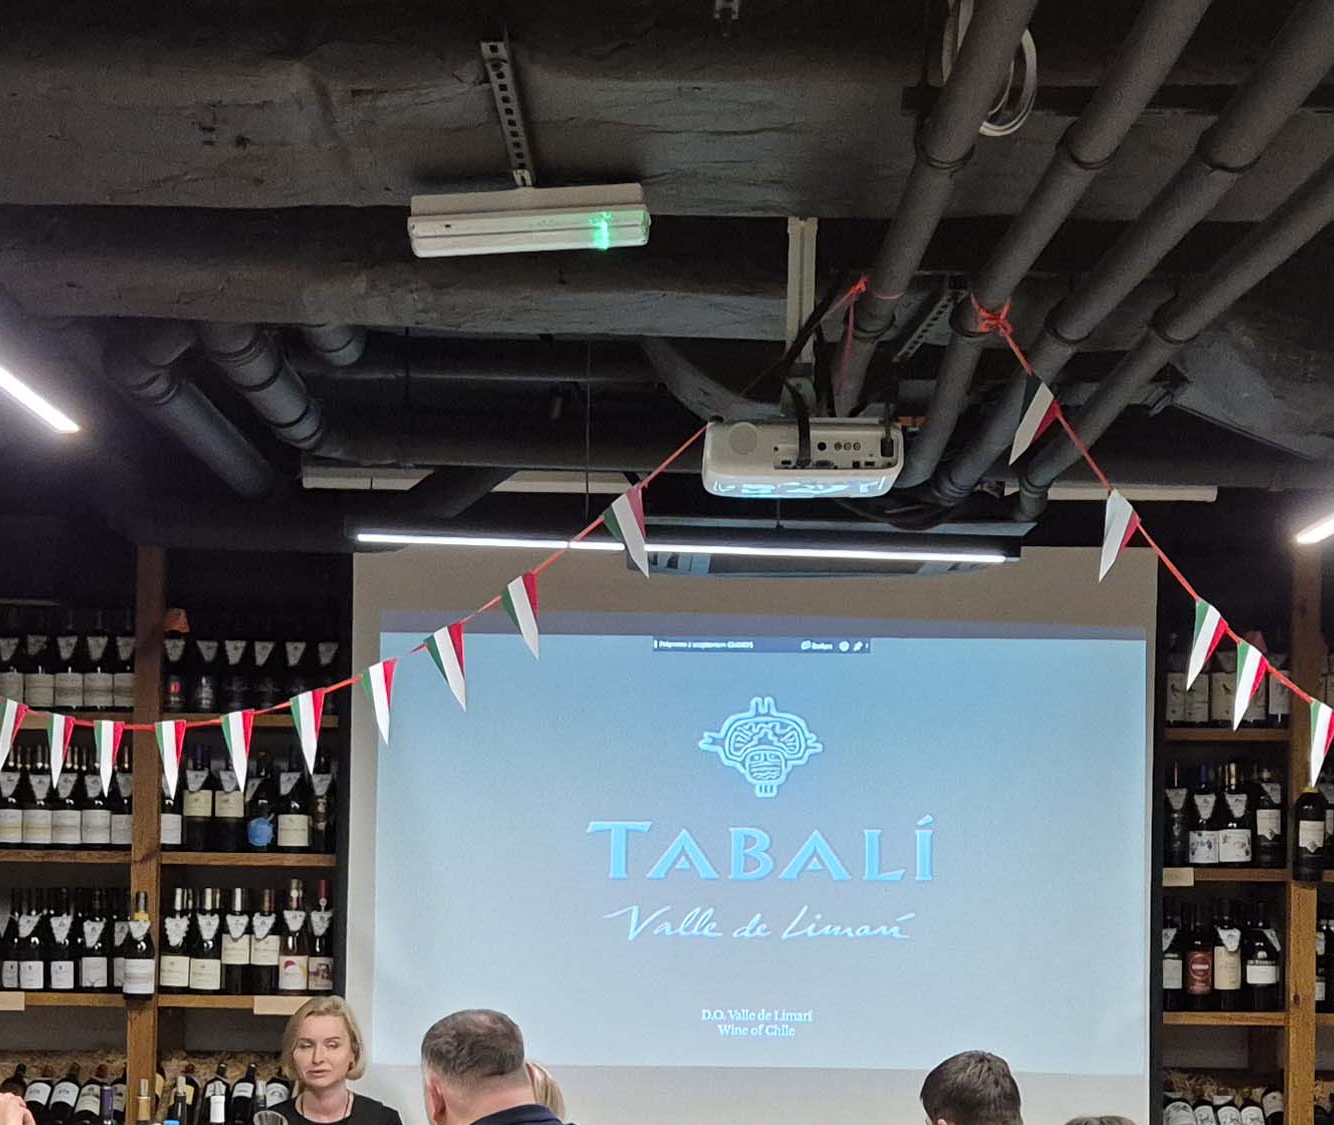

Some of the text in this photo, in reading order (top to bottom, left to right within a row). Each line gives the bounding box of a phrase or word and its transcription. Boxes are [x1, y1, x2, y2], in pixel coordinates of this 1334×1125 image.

[586, 814, 934, 881] TABALÍ
[603, 905, 723, 940] Valle
[732, 913, 771, 939] de
[701, 1009, 726, 1021] D.O.
[728, 1009, 756, 1021] Valle
[757, 1009, 772, 1021] de
[717, 1024, 796, 1037] Wine of Chile
